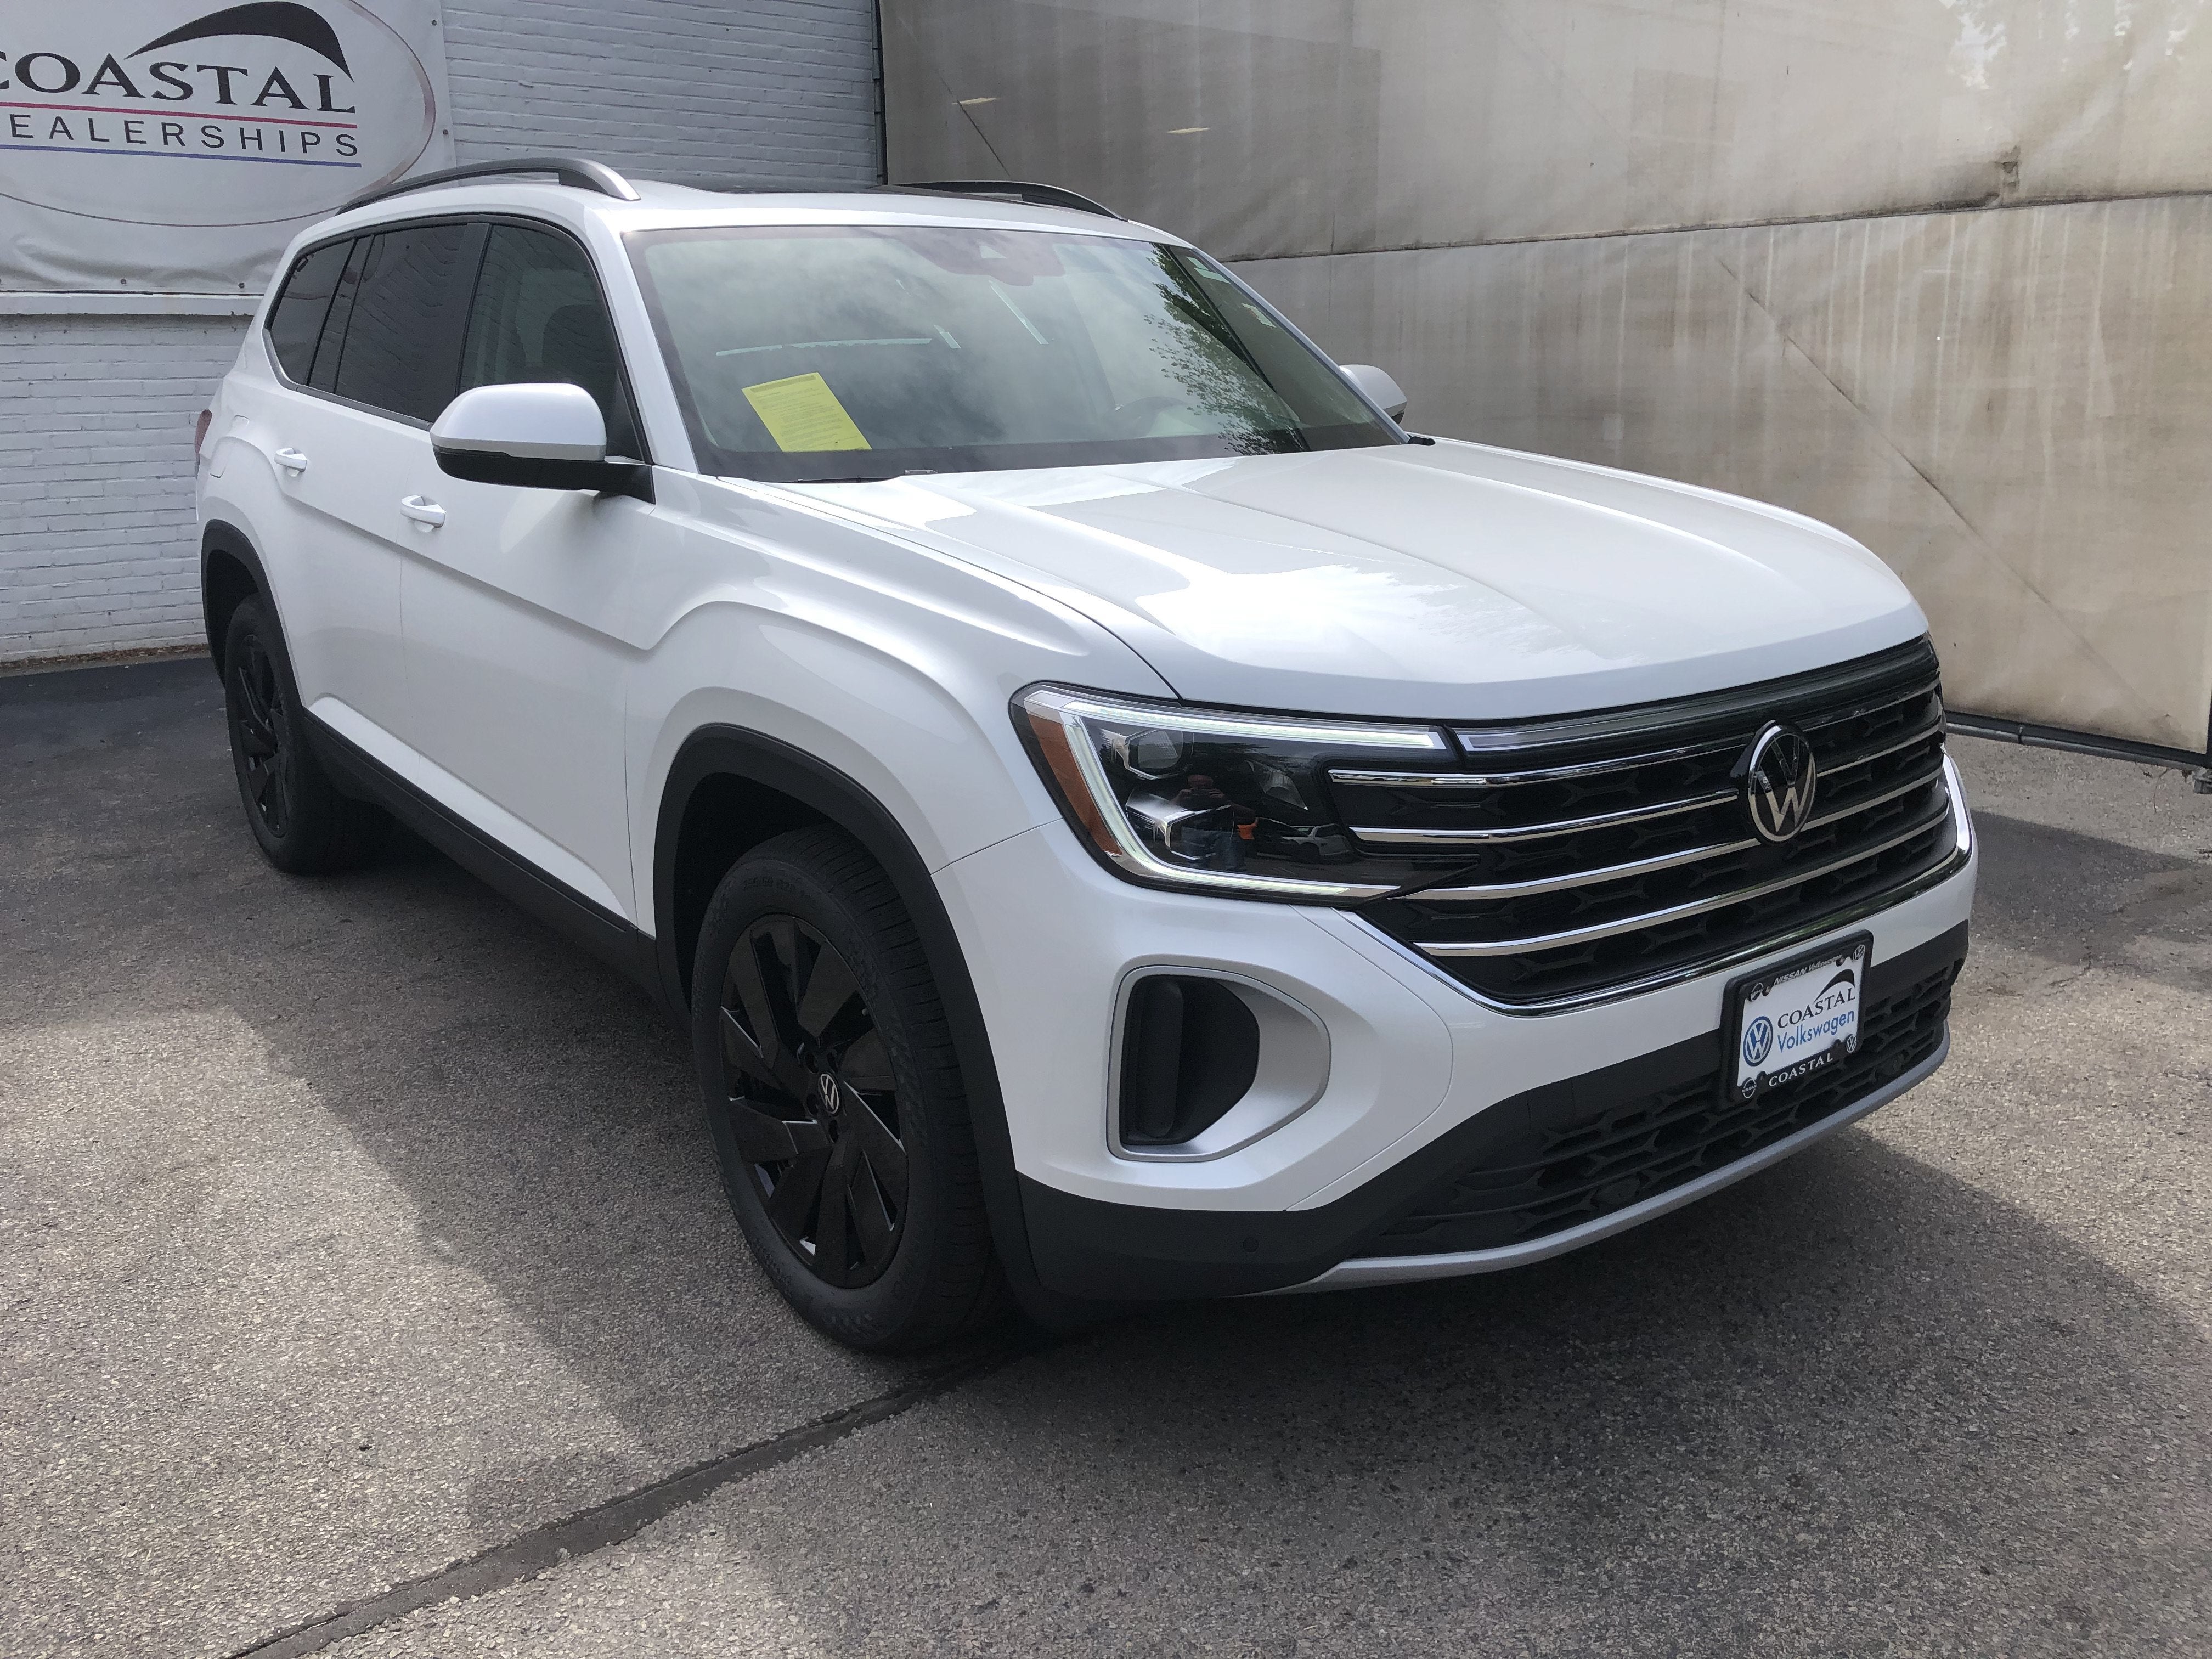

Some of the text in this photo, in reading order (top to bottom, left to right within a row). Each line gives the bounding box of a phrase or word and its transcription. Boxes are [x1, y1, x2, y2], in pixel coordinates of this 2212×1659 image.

[0, 51, 356, 114] OASTAL
[9, 113, 358, 157] EALERSHIPS
[1773, 967, 1807, 986] NISSAN
[1777, 988, 1856, 1029] COASTAL
[1777, 1009, 1855, 1053] Volkswagen
[1768, 1052, 1833, 1087] COASTAL
